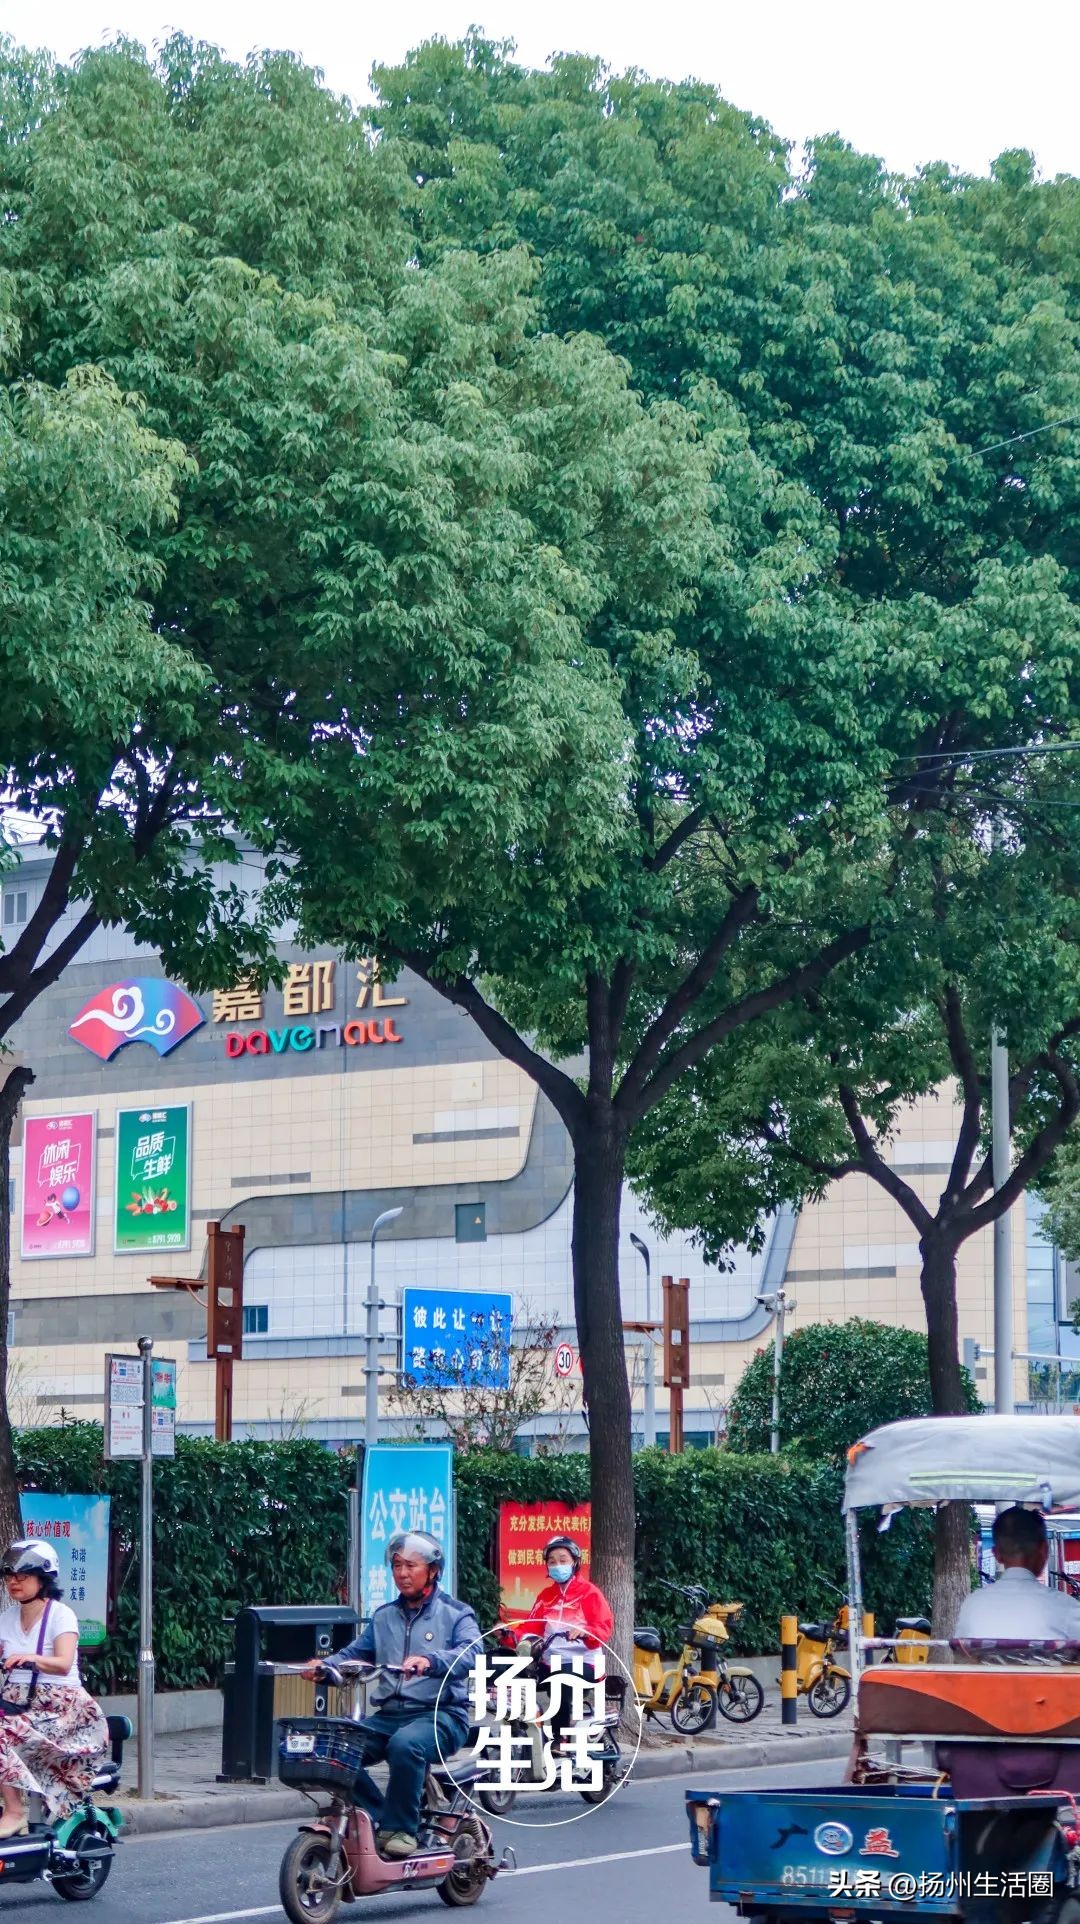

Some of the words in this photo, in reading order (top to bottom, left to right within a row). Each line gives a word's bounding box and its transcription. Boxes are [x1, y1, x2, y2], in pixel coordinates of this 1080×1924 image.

[212, 955, 408, 1024] 嘉都汇
[43, 1139, 71, 1166] 休闲
[135, 1131, 165, 1159] 品质
[48, 1160, 77, 1187] 娱乐
[142, 1153, 172, 1180] 生鲜
[559, 1351, 570, 1369] 30
[369, 1487, 446, 1541] 公交站台
[22, 1520, 71, 1537] 核心价值观
[71, 1548, 86, 1562] 和谐
[70, 1567, 86, 1581] 法治
[70, 1587, 85, 1600] 友善
